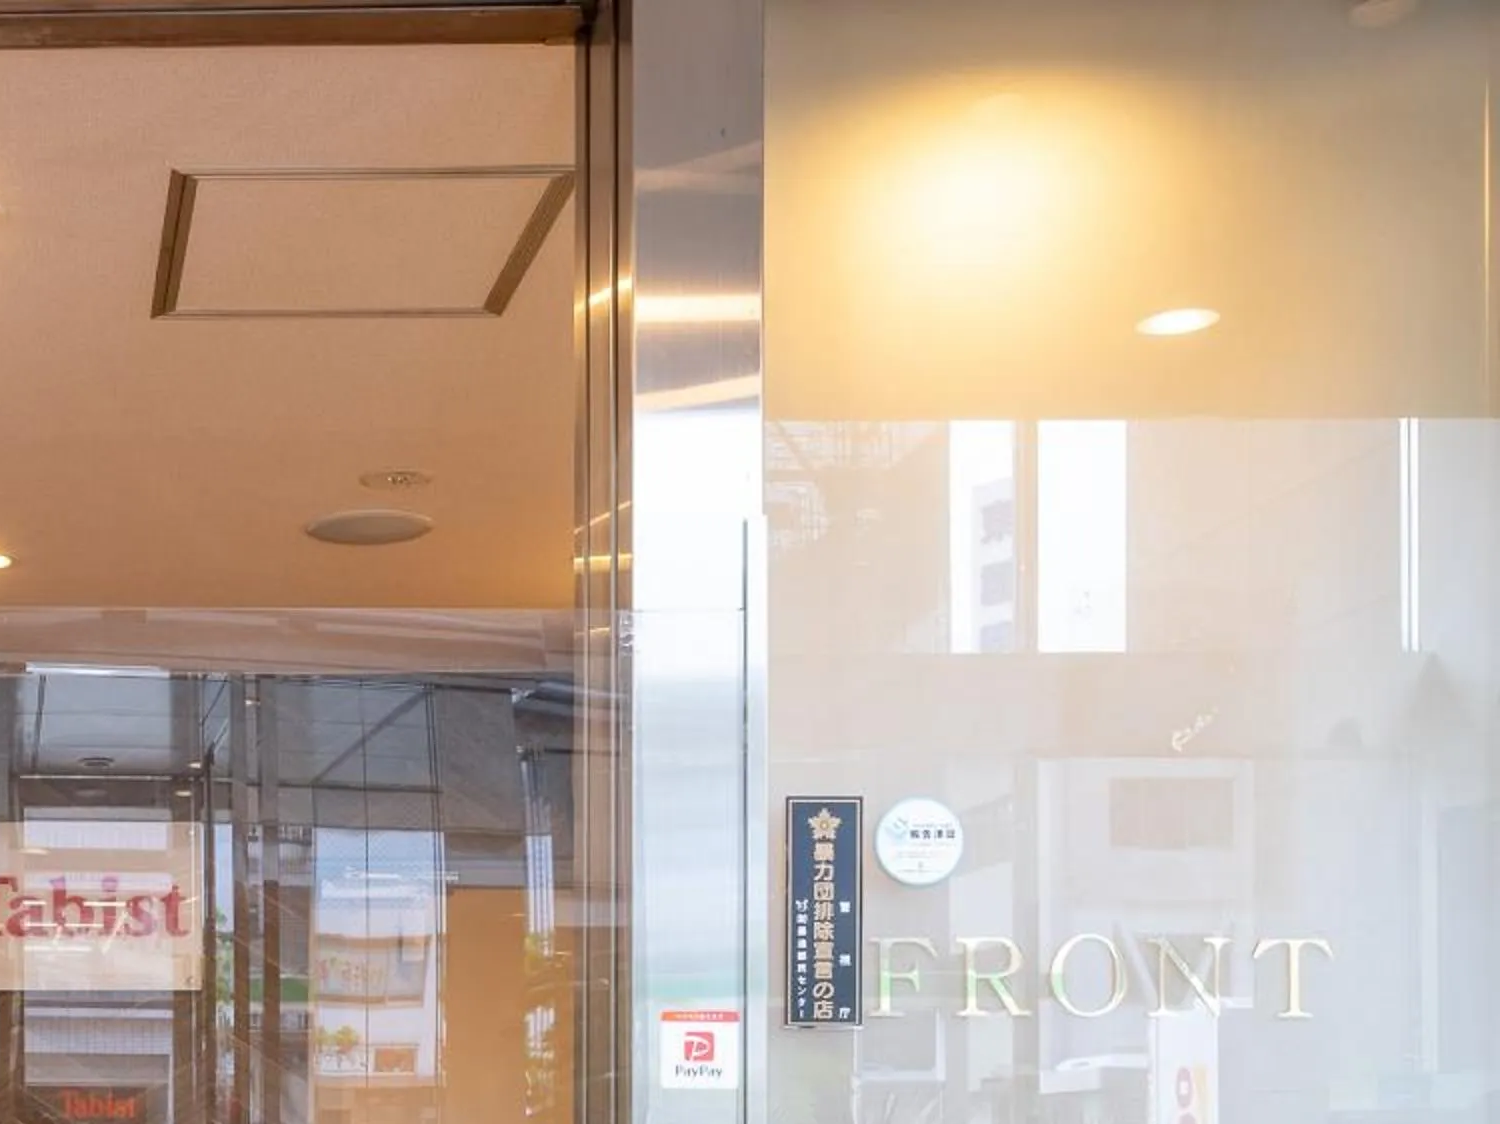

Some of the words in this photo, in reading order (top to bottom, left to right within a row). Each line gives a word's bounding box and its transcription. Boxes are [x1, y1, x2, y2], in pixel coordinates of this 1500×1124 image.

[813, 842, 836, 1020] 暴力団排除宣言の店
[868, 932, 1336, 1019] FRONT
[675, 1064, 723, 1078] PayPay
